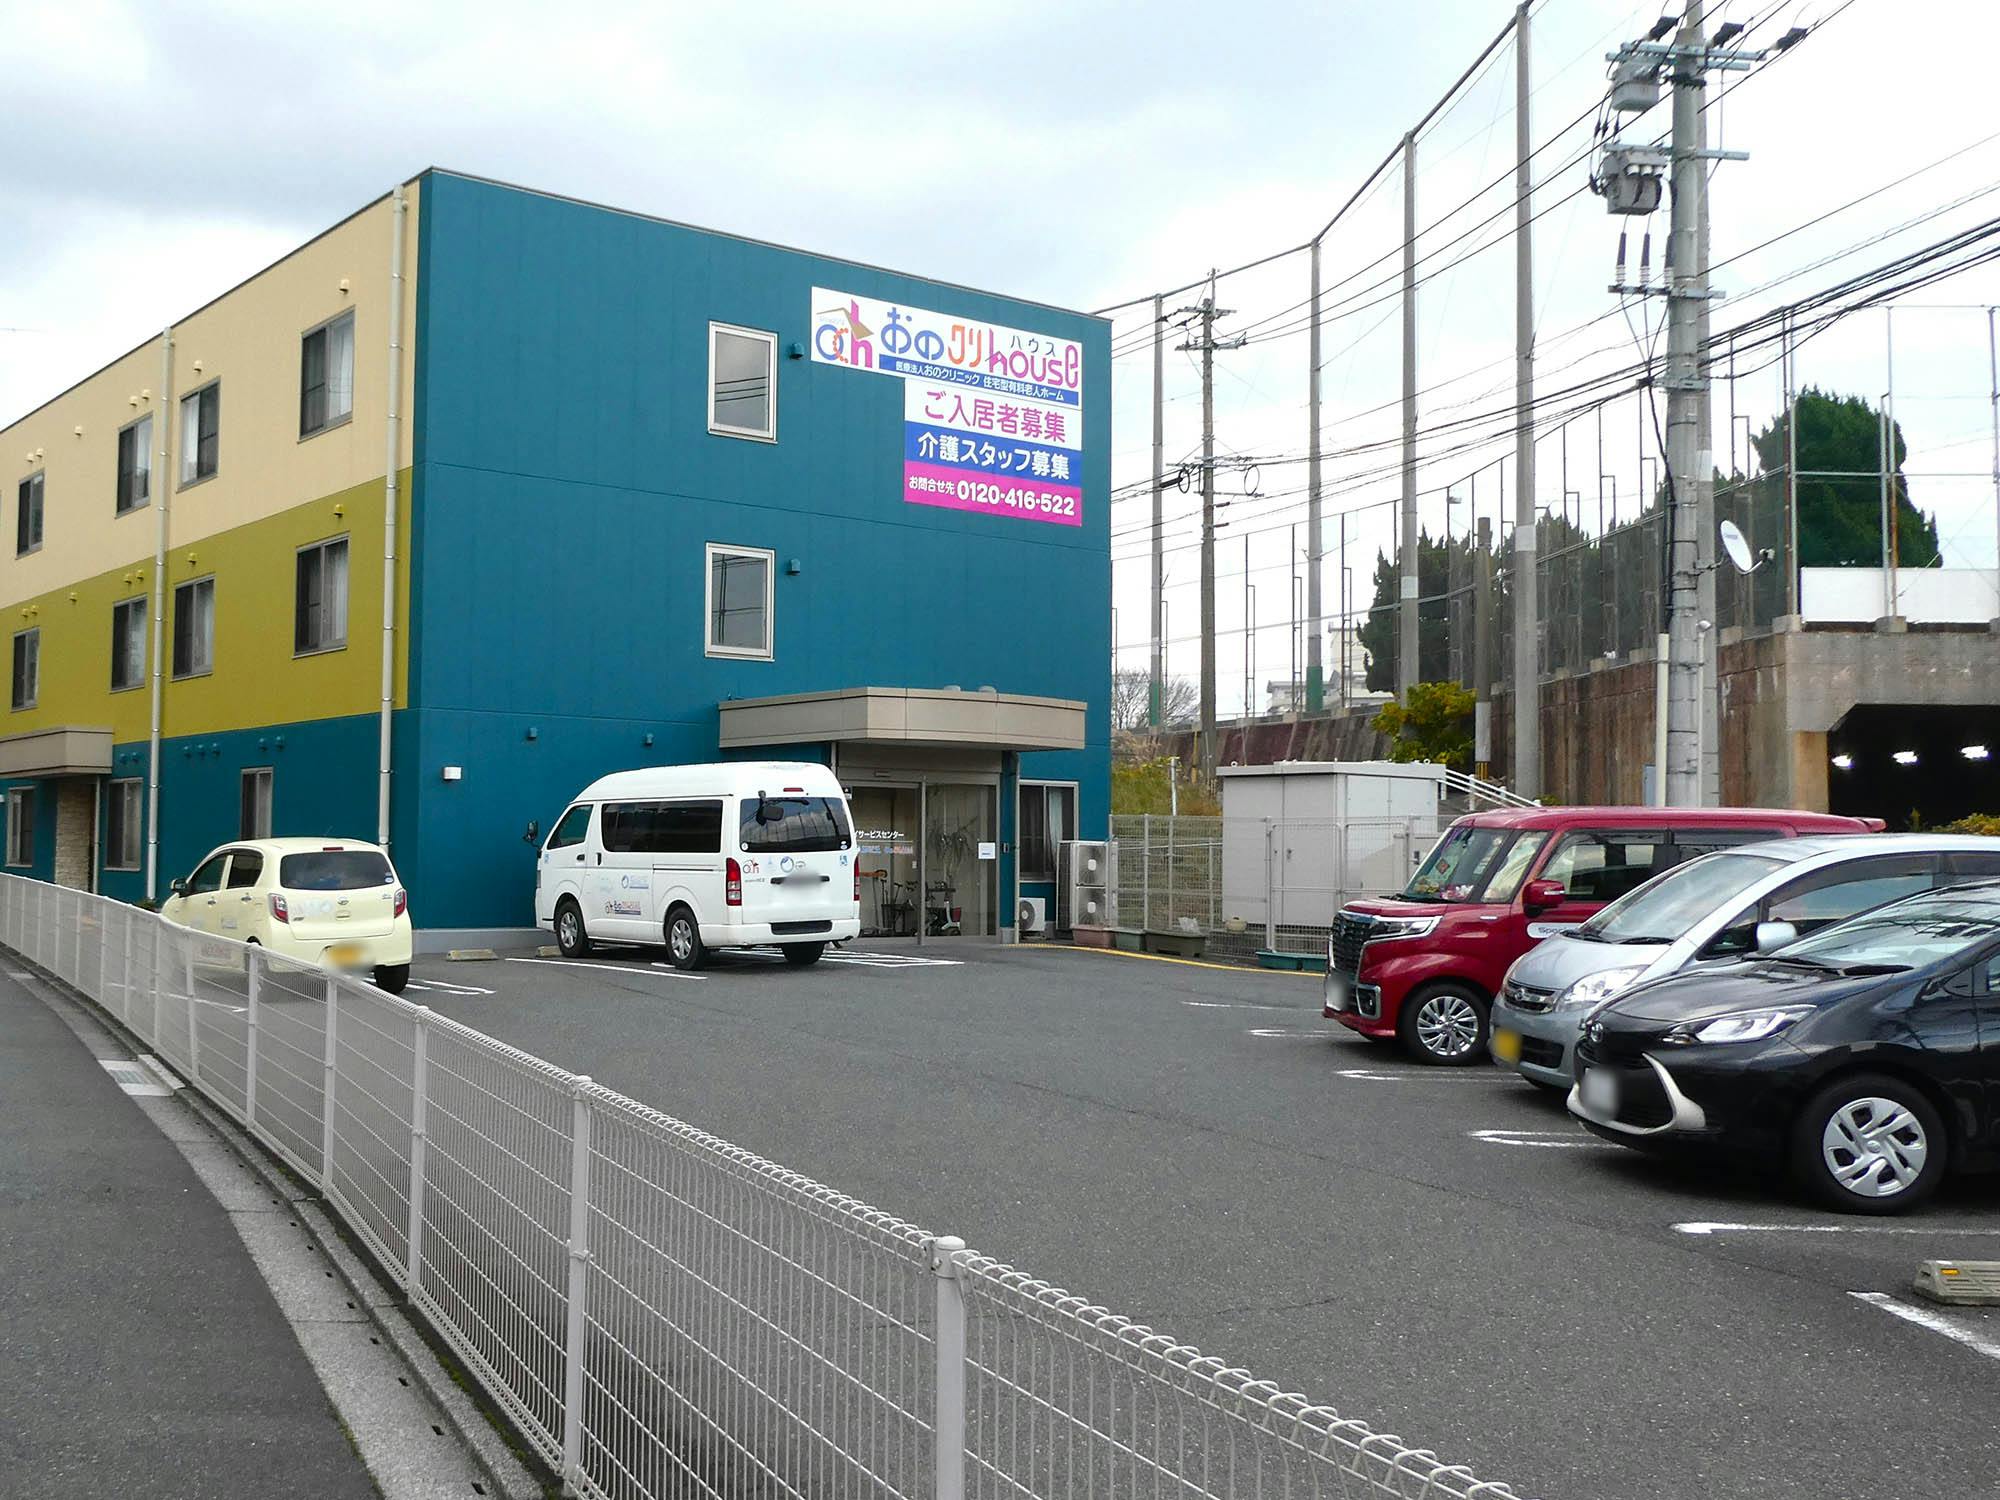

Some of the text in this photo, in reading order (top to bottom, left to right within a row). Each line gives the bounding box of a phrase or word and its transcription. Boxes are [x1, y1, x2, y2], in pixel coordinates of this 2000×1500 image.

[1010, 335, 1056, 357] ハウス
[895, 360, 1064, 401] 医療法人おのクリニック 住宅型有料老人ホーム
[925, 391, 1066, 443] ご入居者募集
[917, 431, 1070, 480] 介護スタッフ募集
[909, 475, 955, 495] お問合せ先
